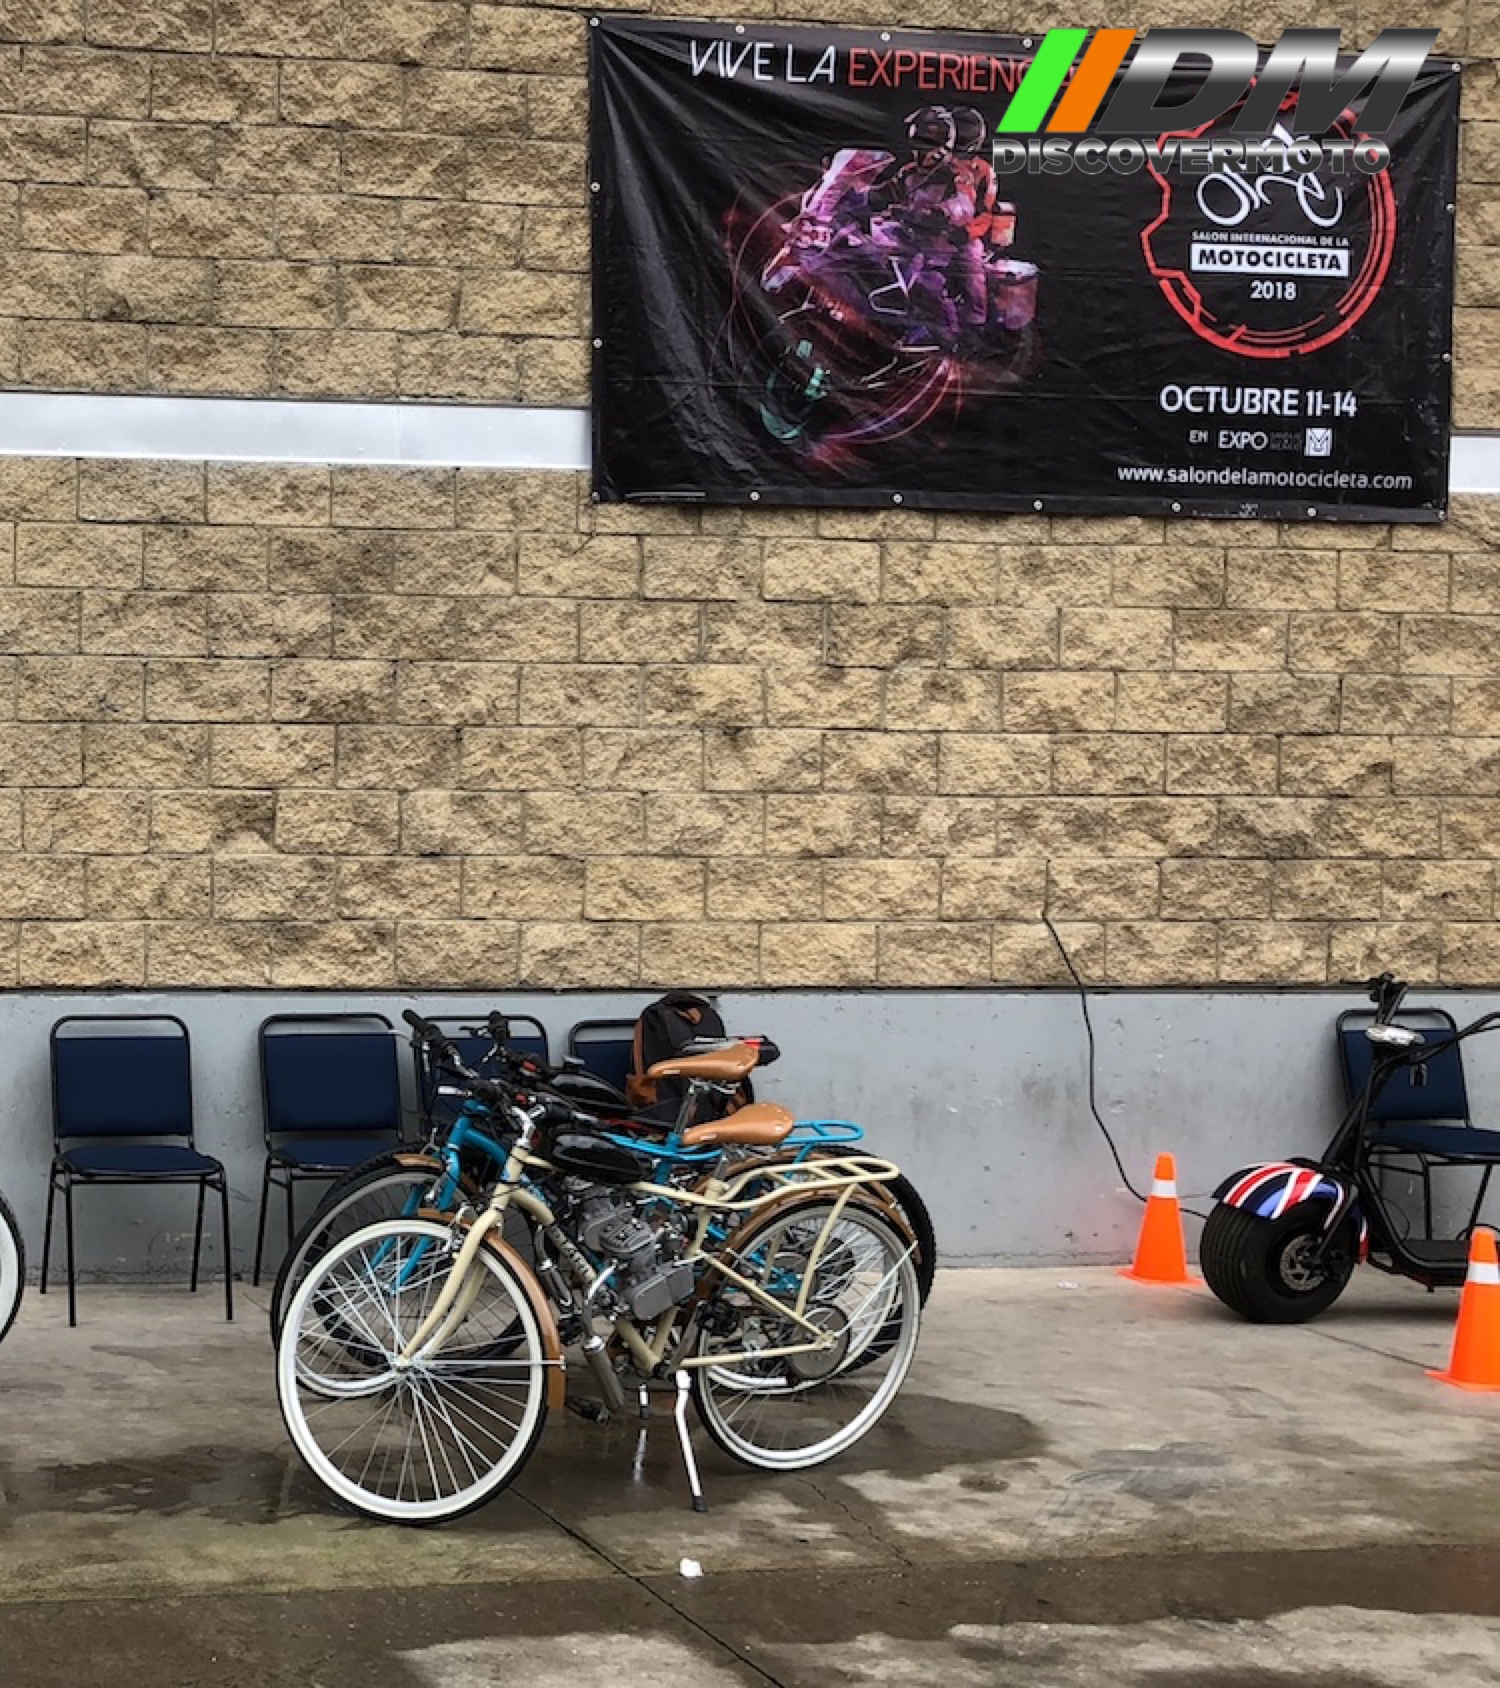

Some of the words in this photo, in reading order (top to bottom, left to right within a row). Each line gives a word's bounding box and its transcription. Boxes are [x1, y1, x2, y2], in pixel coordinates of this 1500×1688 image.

[689, 38, 774, 82] VIVE
[786, 43, 837, 84] LA
[1229, 232, 1319, 246] INTERNACIONAL
[1319, 235, 1334, 247] DE
[1335, 237, 1349, 247] LA
[1198, 248, 1342, 271] MOTOCICLETA
[1250, 279, 1297, 301] 2018
[1159, 384, 1300, 415] OCTUBRE
[1305, 389, 1358, 418] 11-14
[1217, 429, 1269, 451] EXPO
[1117, 466, 1413, 490] www.salondelamotocicleta.com
